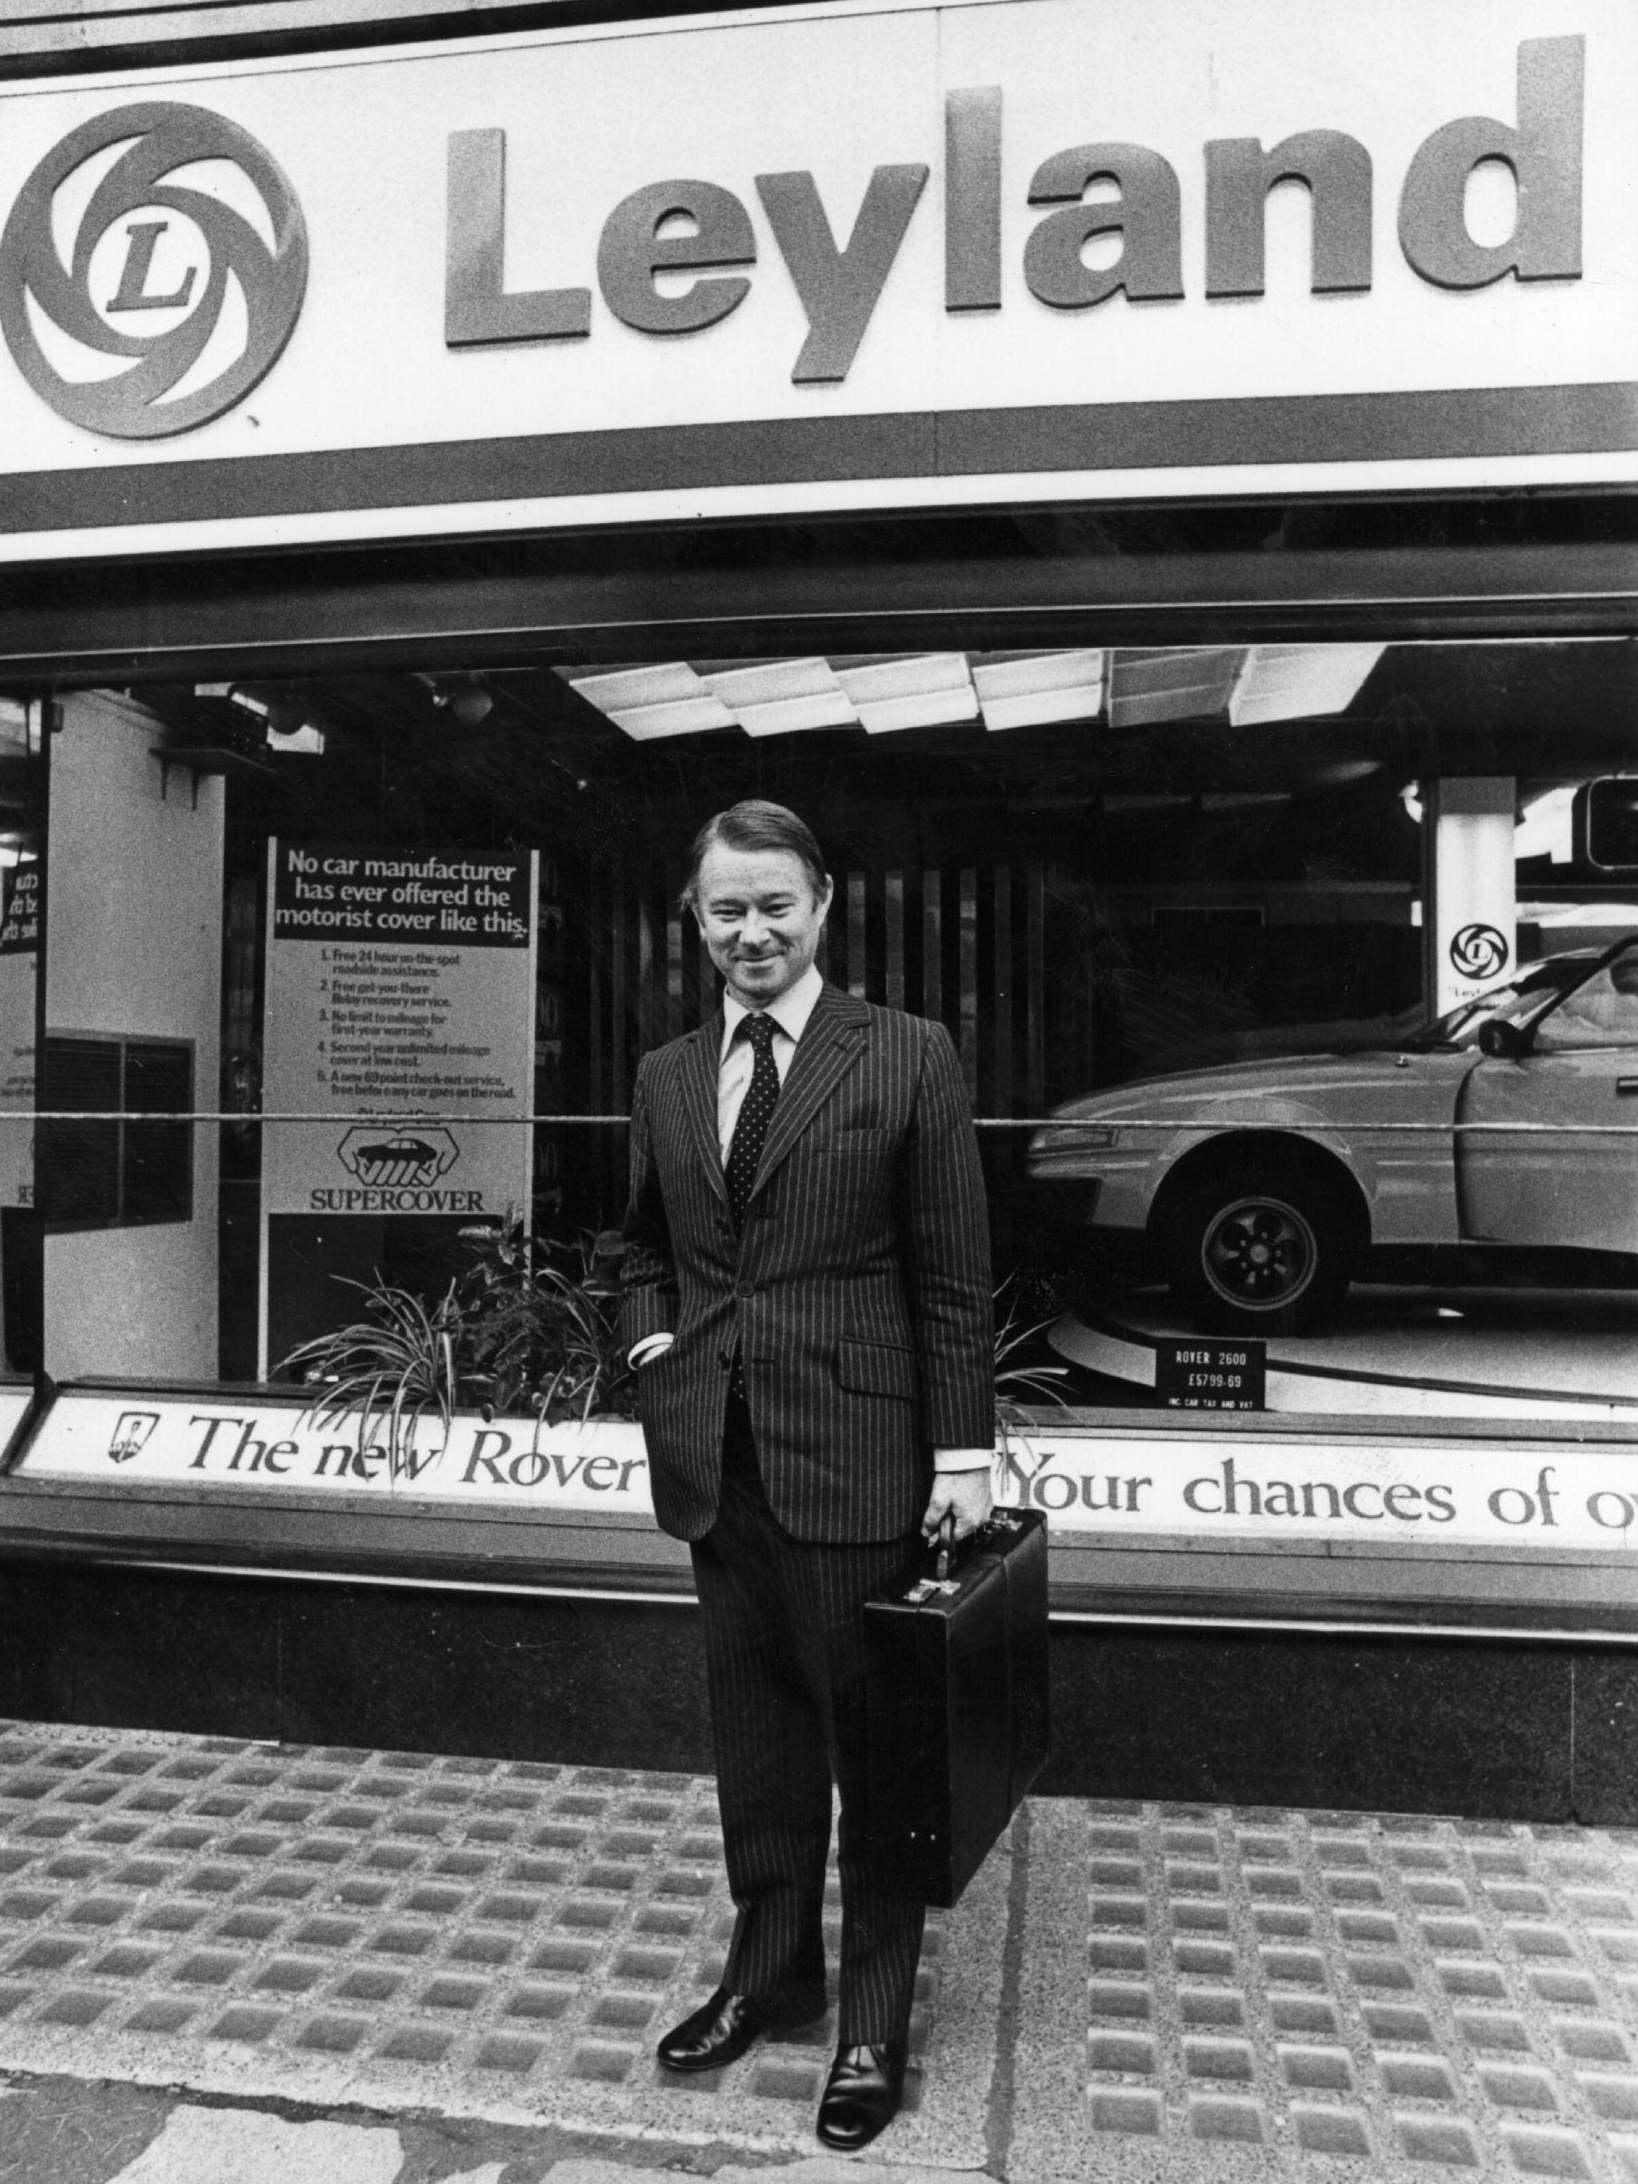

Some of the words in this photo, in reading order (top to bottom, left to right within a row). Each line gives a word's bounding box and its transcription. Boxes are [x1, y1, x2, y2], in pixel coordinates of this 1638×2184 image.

[445, 34, 1586, 386] Leyland
[106, 221, 197, 313] L
[288, 849, 318, 873] No
[323, 858, 359, 875] car
[365, 857, 517, 882] manufacturer
[295, 876, 335, 900] has
[340, 885, 387, 902] ever
[391, 882, 469, 906] offered
[474, 884, 511, 907] the
[276, 906, 373, 928] motorist
[377, 913, 436, 930] cover
[441, 909, 478, 932] like
[483, 911, 528, 933] this.
[333, 949, 357, 962] Free
[311, 1189, 484, 1211] SUPERCOVER
[1176, 1351, 1210, 1364] ROVER
[1219, 1352, 1247, 1365] 2600
[188, 1415, 299, 1472] The
[313, 1444, 442, 1481] new
[459, 1429, 646, 1492] Rover
[997, 1452, 1152, 1512] Your
[1182, 1458, 1457, 1523] chances
[1488, 1466, 1559, 1527] of
